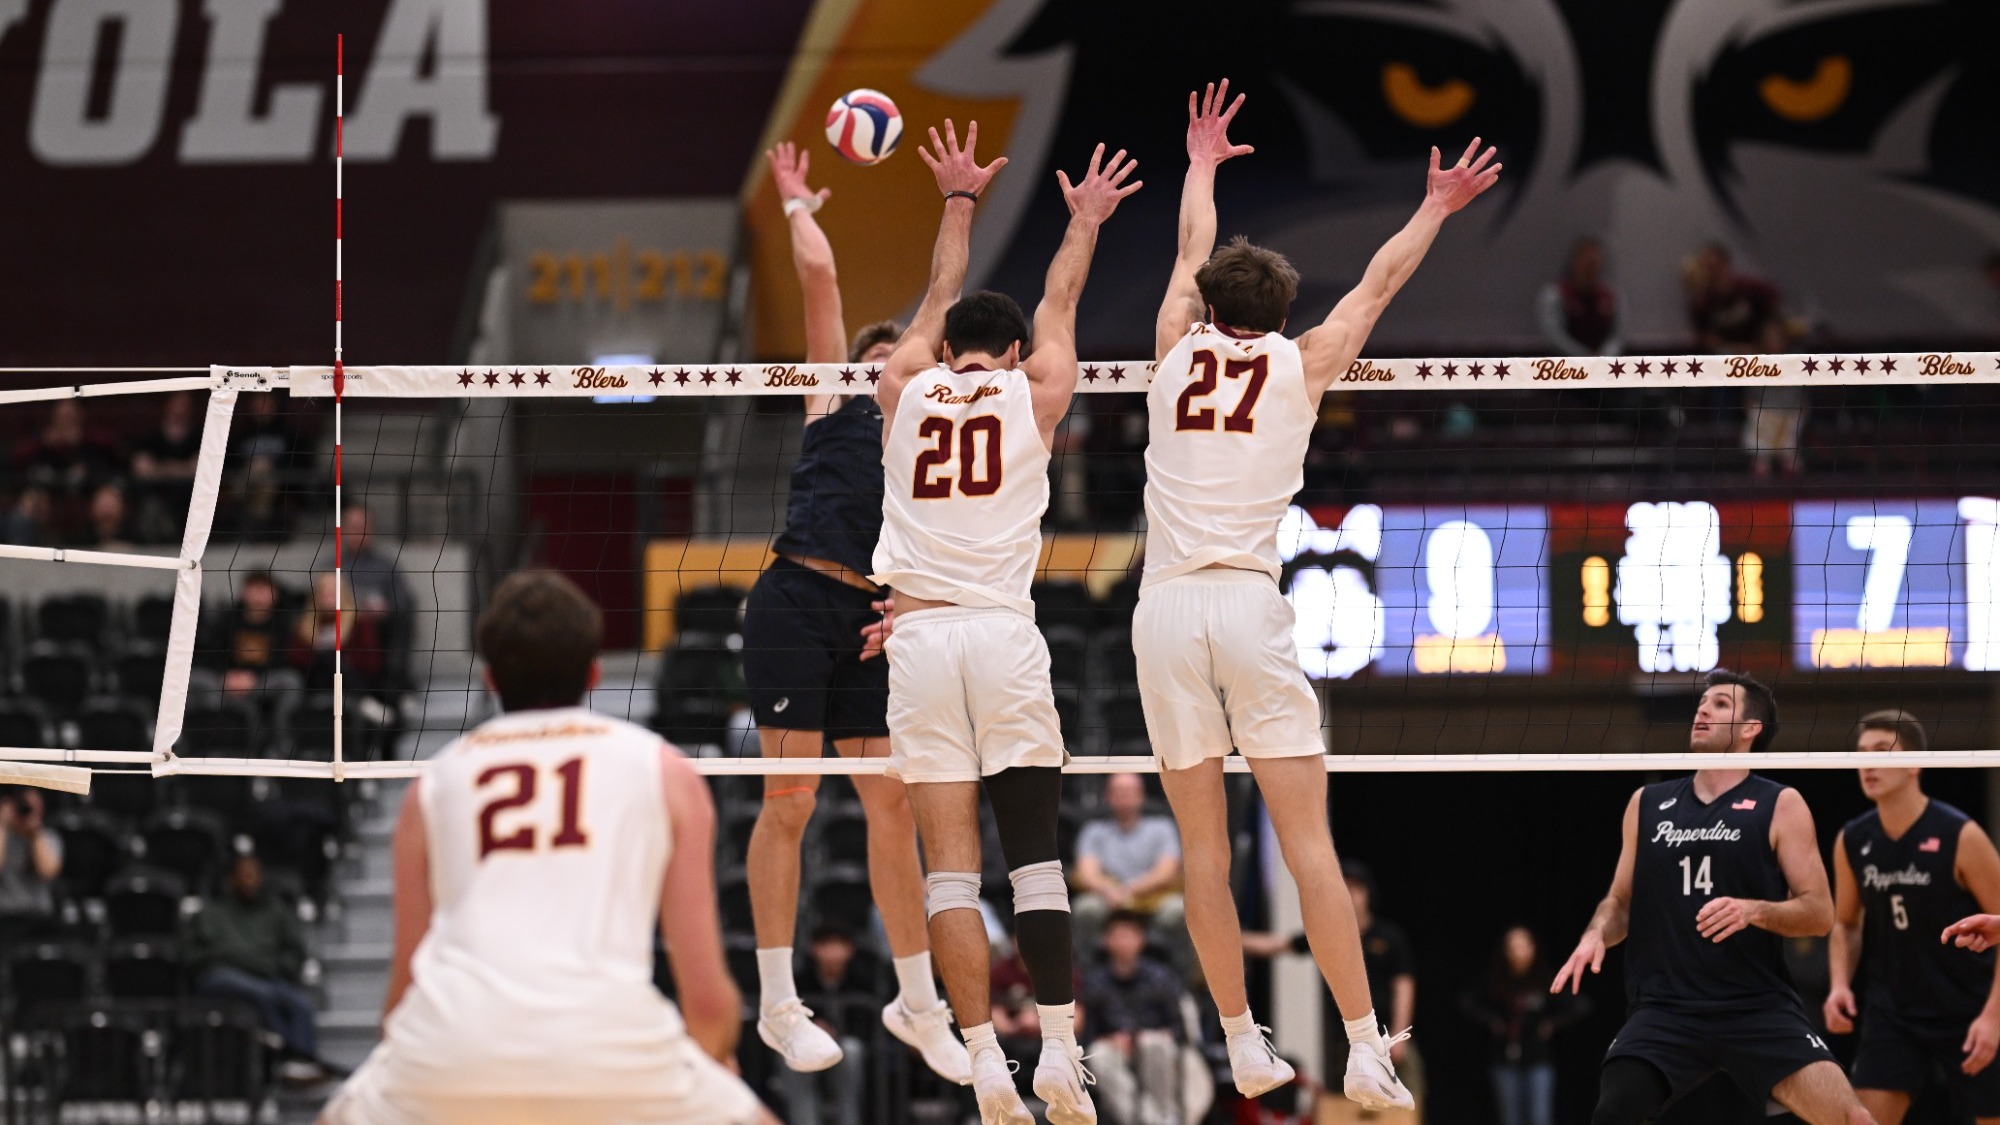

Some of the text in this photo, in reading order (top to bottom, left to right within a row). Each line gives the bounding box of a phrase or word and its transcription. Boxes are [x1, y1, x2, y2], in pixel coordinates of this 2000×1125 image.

[0, 0, 501, 165] OLA
[1175, 348, 1270, 434] 27
[912, 414, 1003, 500] 20
[1846, 515, 1913, 633] 7
[473, 752, 591, 866] 21
[1651, 820, 1741, 848] Pepperdine
[1678, 855, 1714, 896] 14
[1890, 894, 1909, 930] 5
